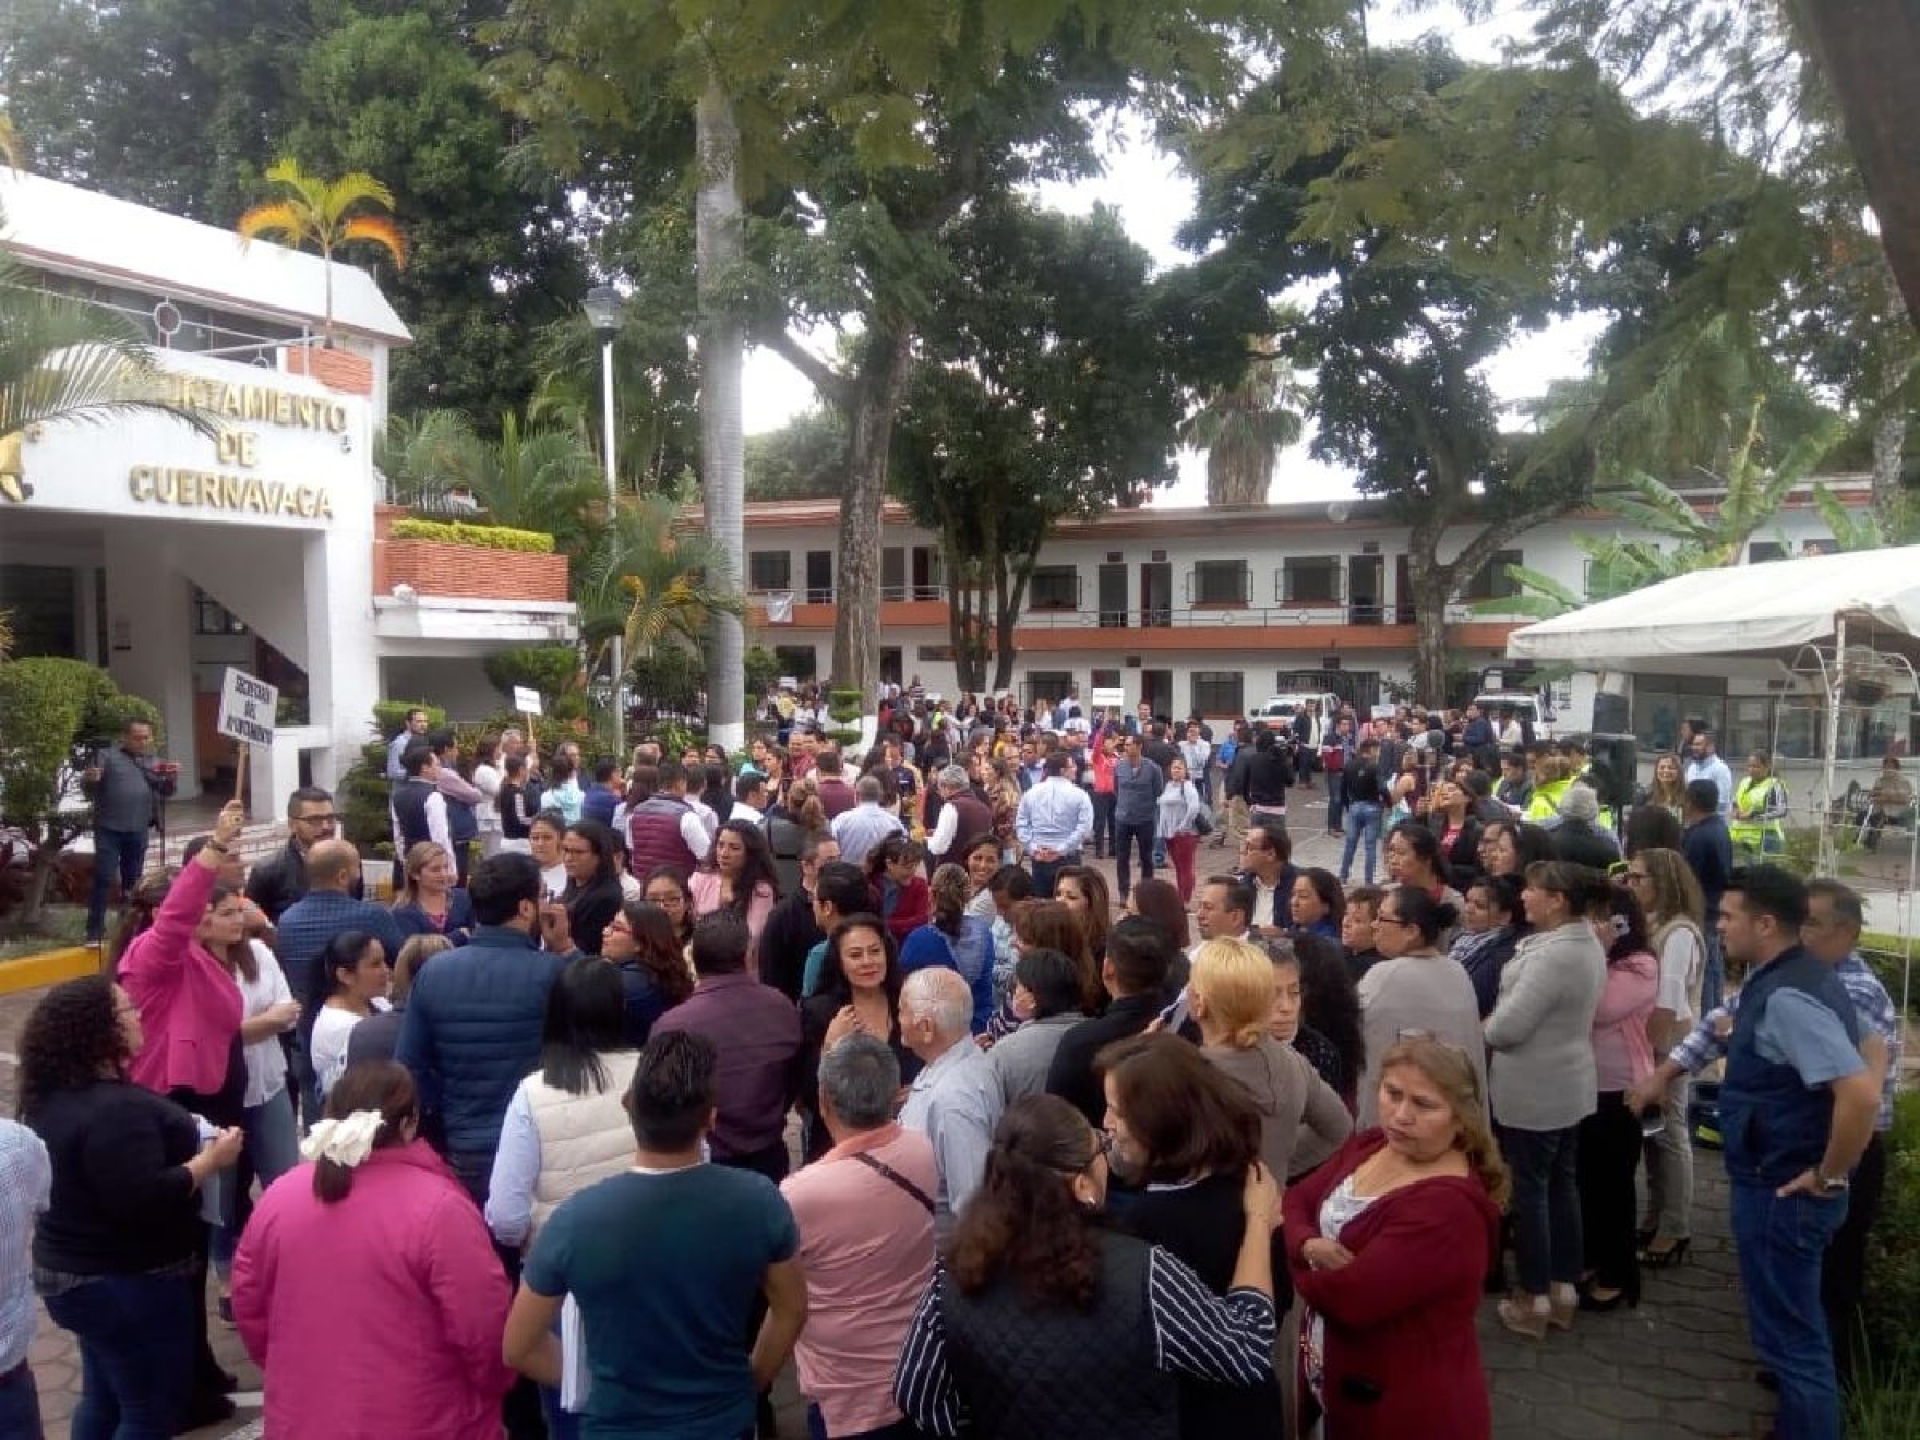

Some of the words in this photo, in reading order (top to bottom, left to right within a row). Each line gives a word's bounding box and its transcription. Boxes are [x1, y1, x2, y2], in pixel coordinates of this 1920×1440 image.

[117, 360, 347, 434] UNTAMIENTO
[216, 425, 258, 468] DE
[129, 464, 334, 519] CUERNAVACA
